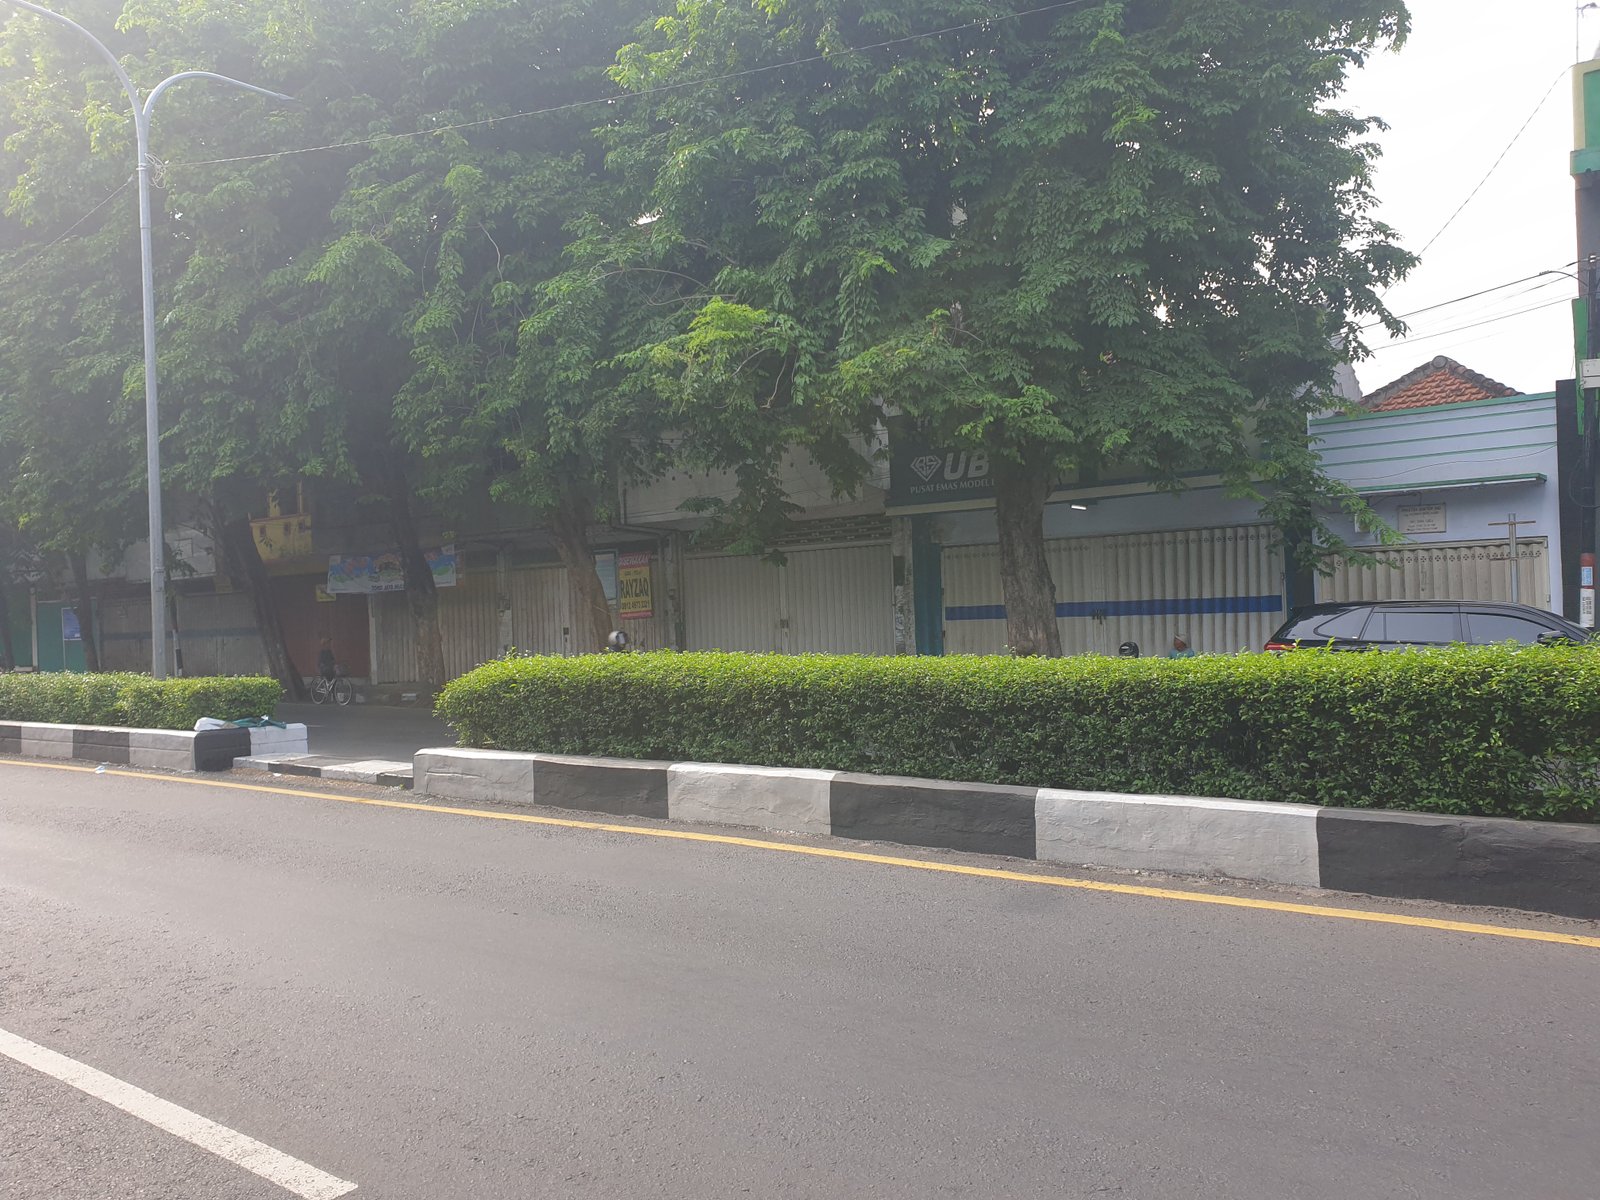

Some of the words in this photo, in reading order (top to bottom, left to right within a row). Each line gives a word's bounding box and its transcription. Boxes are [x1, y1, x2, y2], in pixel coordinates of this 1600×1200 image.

[910, 484, 935, 494] PUSAT
[936, 481, 958, 491] EMAS
[959, 479, 990, 489] MODEL
[620, 577, 649, 598] RAYZAQ
